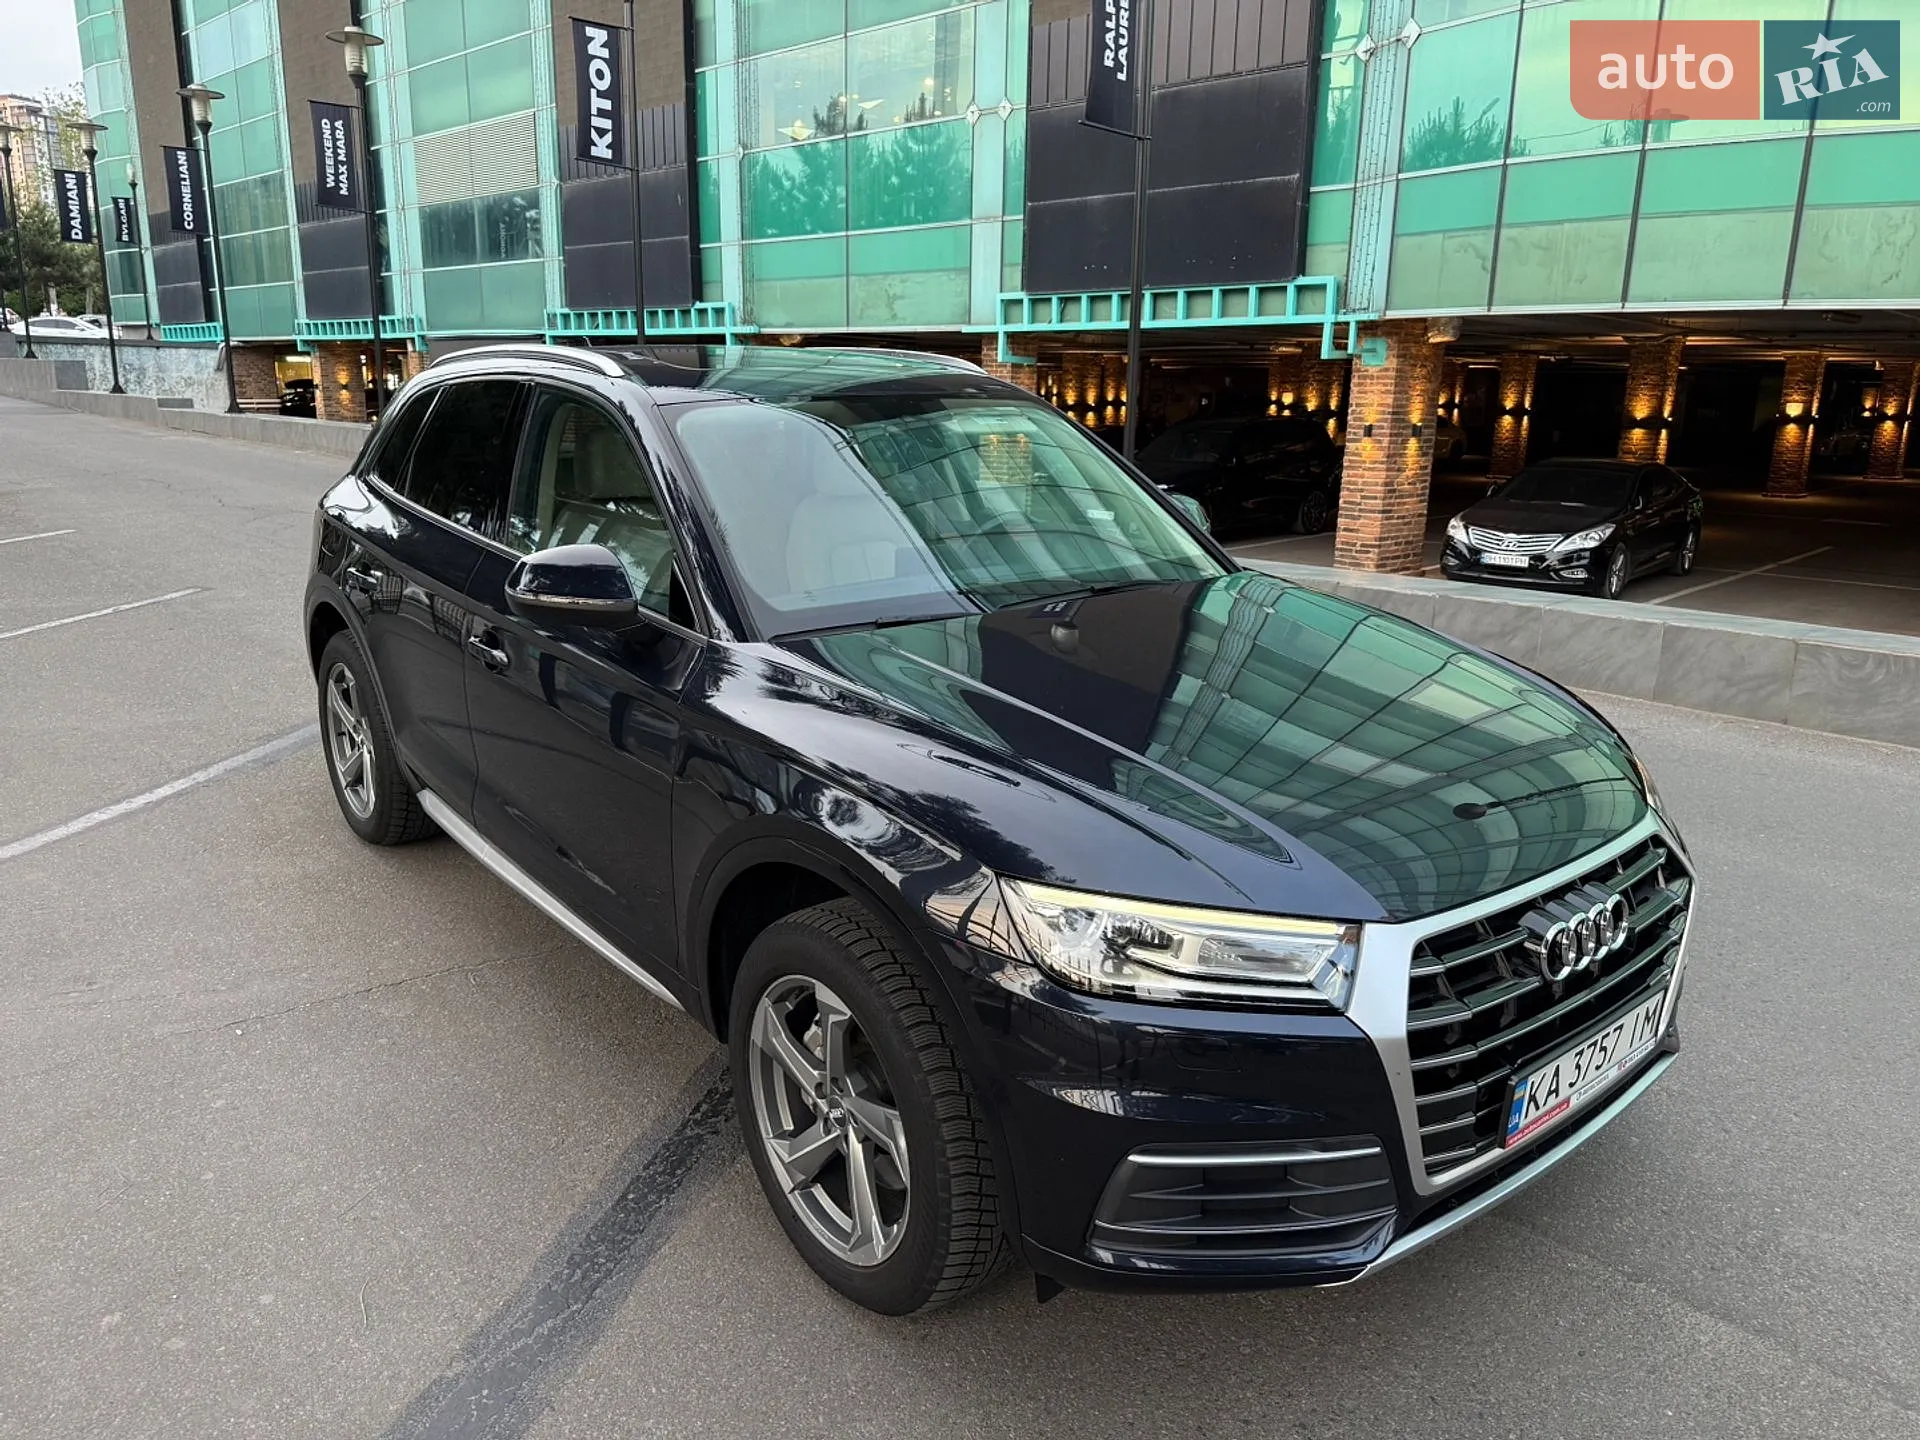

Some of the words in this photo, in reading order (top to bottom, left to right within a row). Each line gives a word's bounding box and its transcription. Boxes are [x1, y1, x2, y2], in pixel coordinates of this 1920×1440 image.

[585, 26, 613, 160] KITON
[321, 118, 336, 188] WEEKEND
[334, 119, 347, 161] MARA
[70, 173, 84, 241] DAMIANI
[176, 150, 194, 230] CORNELIANI
[338, 163, 349, 196] MAX
[117, 198, 129, 242] BVLGARI
[1525, 1063, 1560, 1120] KA
[1568, 1022, 1625, 1088] 3757
[1629, 999, 1660, 1049] IM
